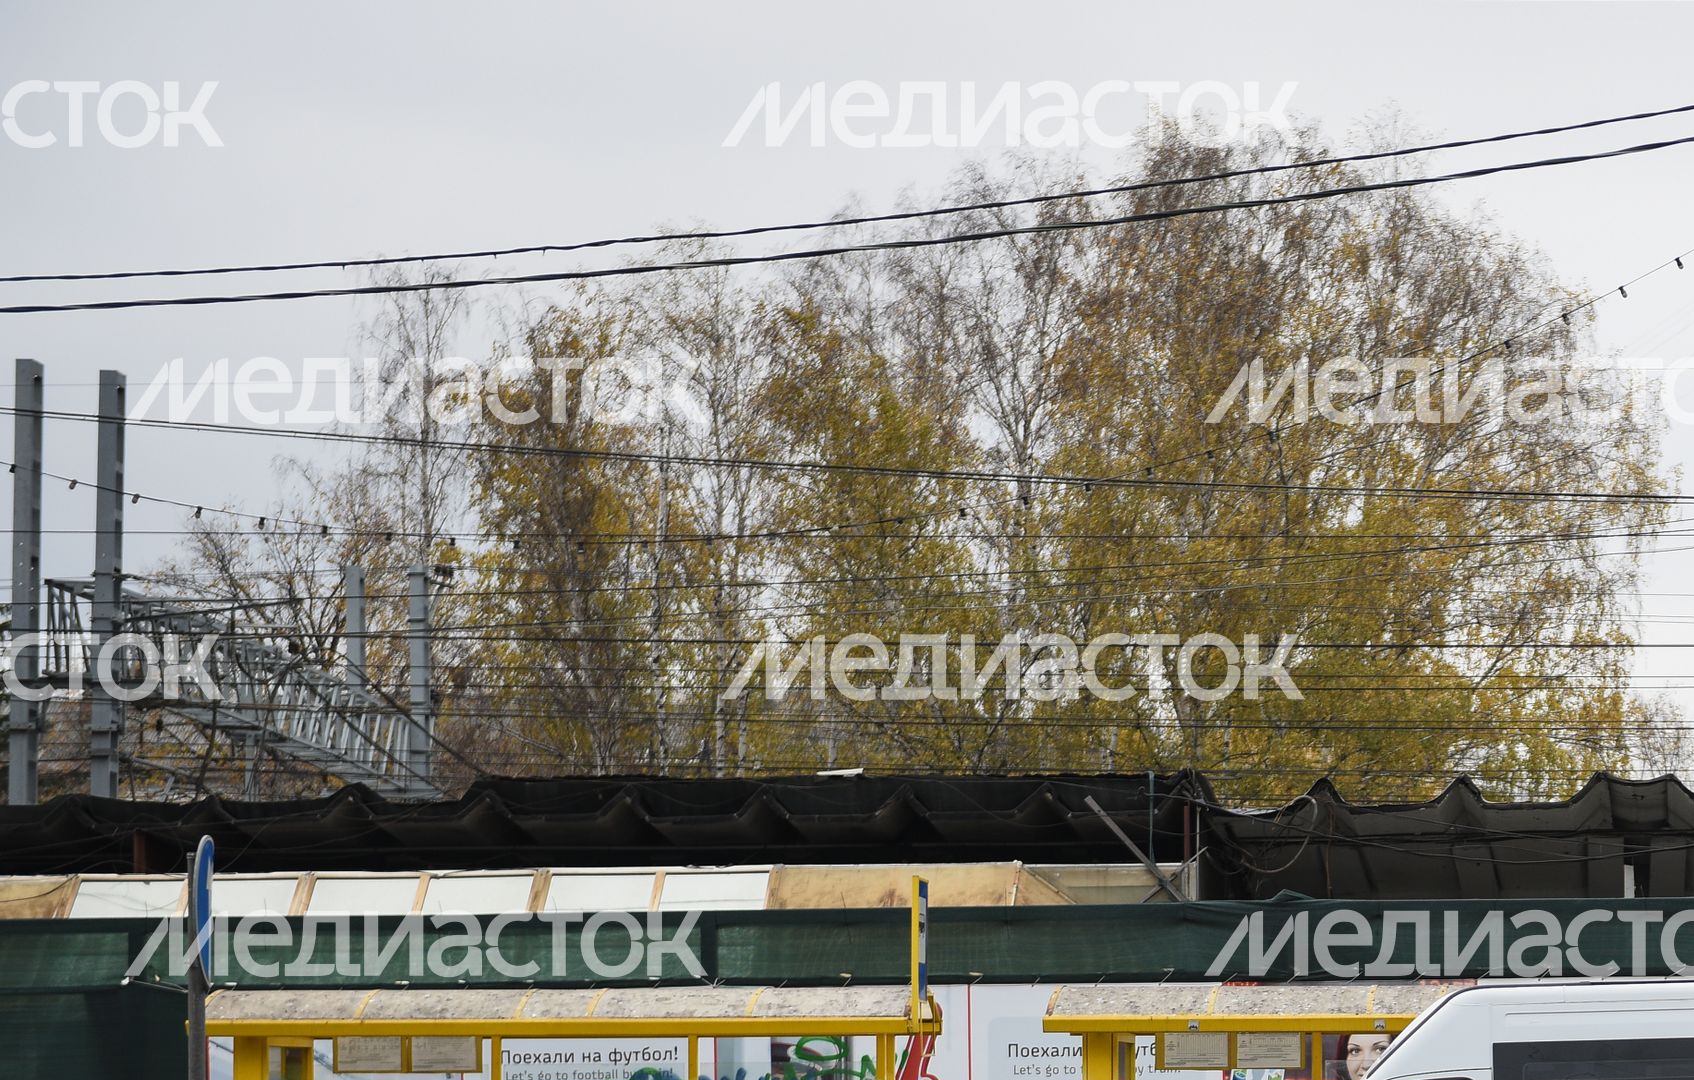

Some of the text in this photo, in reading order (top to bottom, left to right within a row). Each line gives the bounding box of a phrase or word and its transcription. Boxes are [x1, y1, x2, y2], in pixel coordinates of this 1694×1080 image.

[501, 1046, 679, 1066] Поехали на футбол!
[1008, 1043, 1083, 1058] Поехали
[556, 1070, 569, 1080] to
[572, 1068, 618, 1080] football
[1013, 1064, 1041, 1075] Let's
[1045, 1065, 1060, 1077] go
[1063, 1065, 1077, 1075] to
